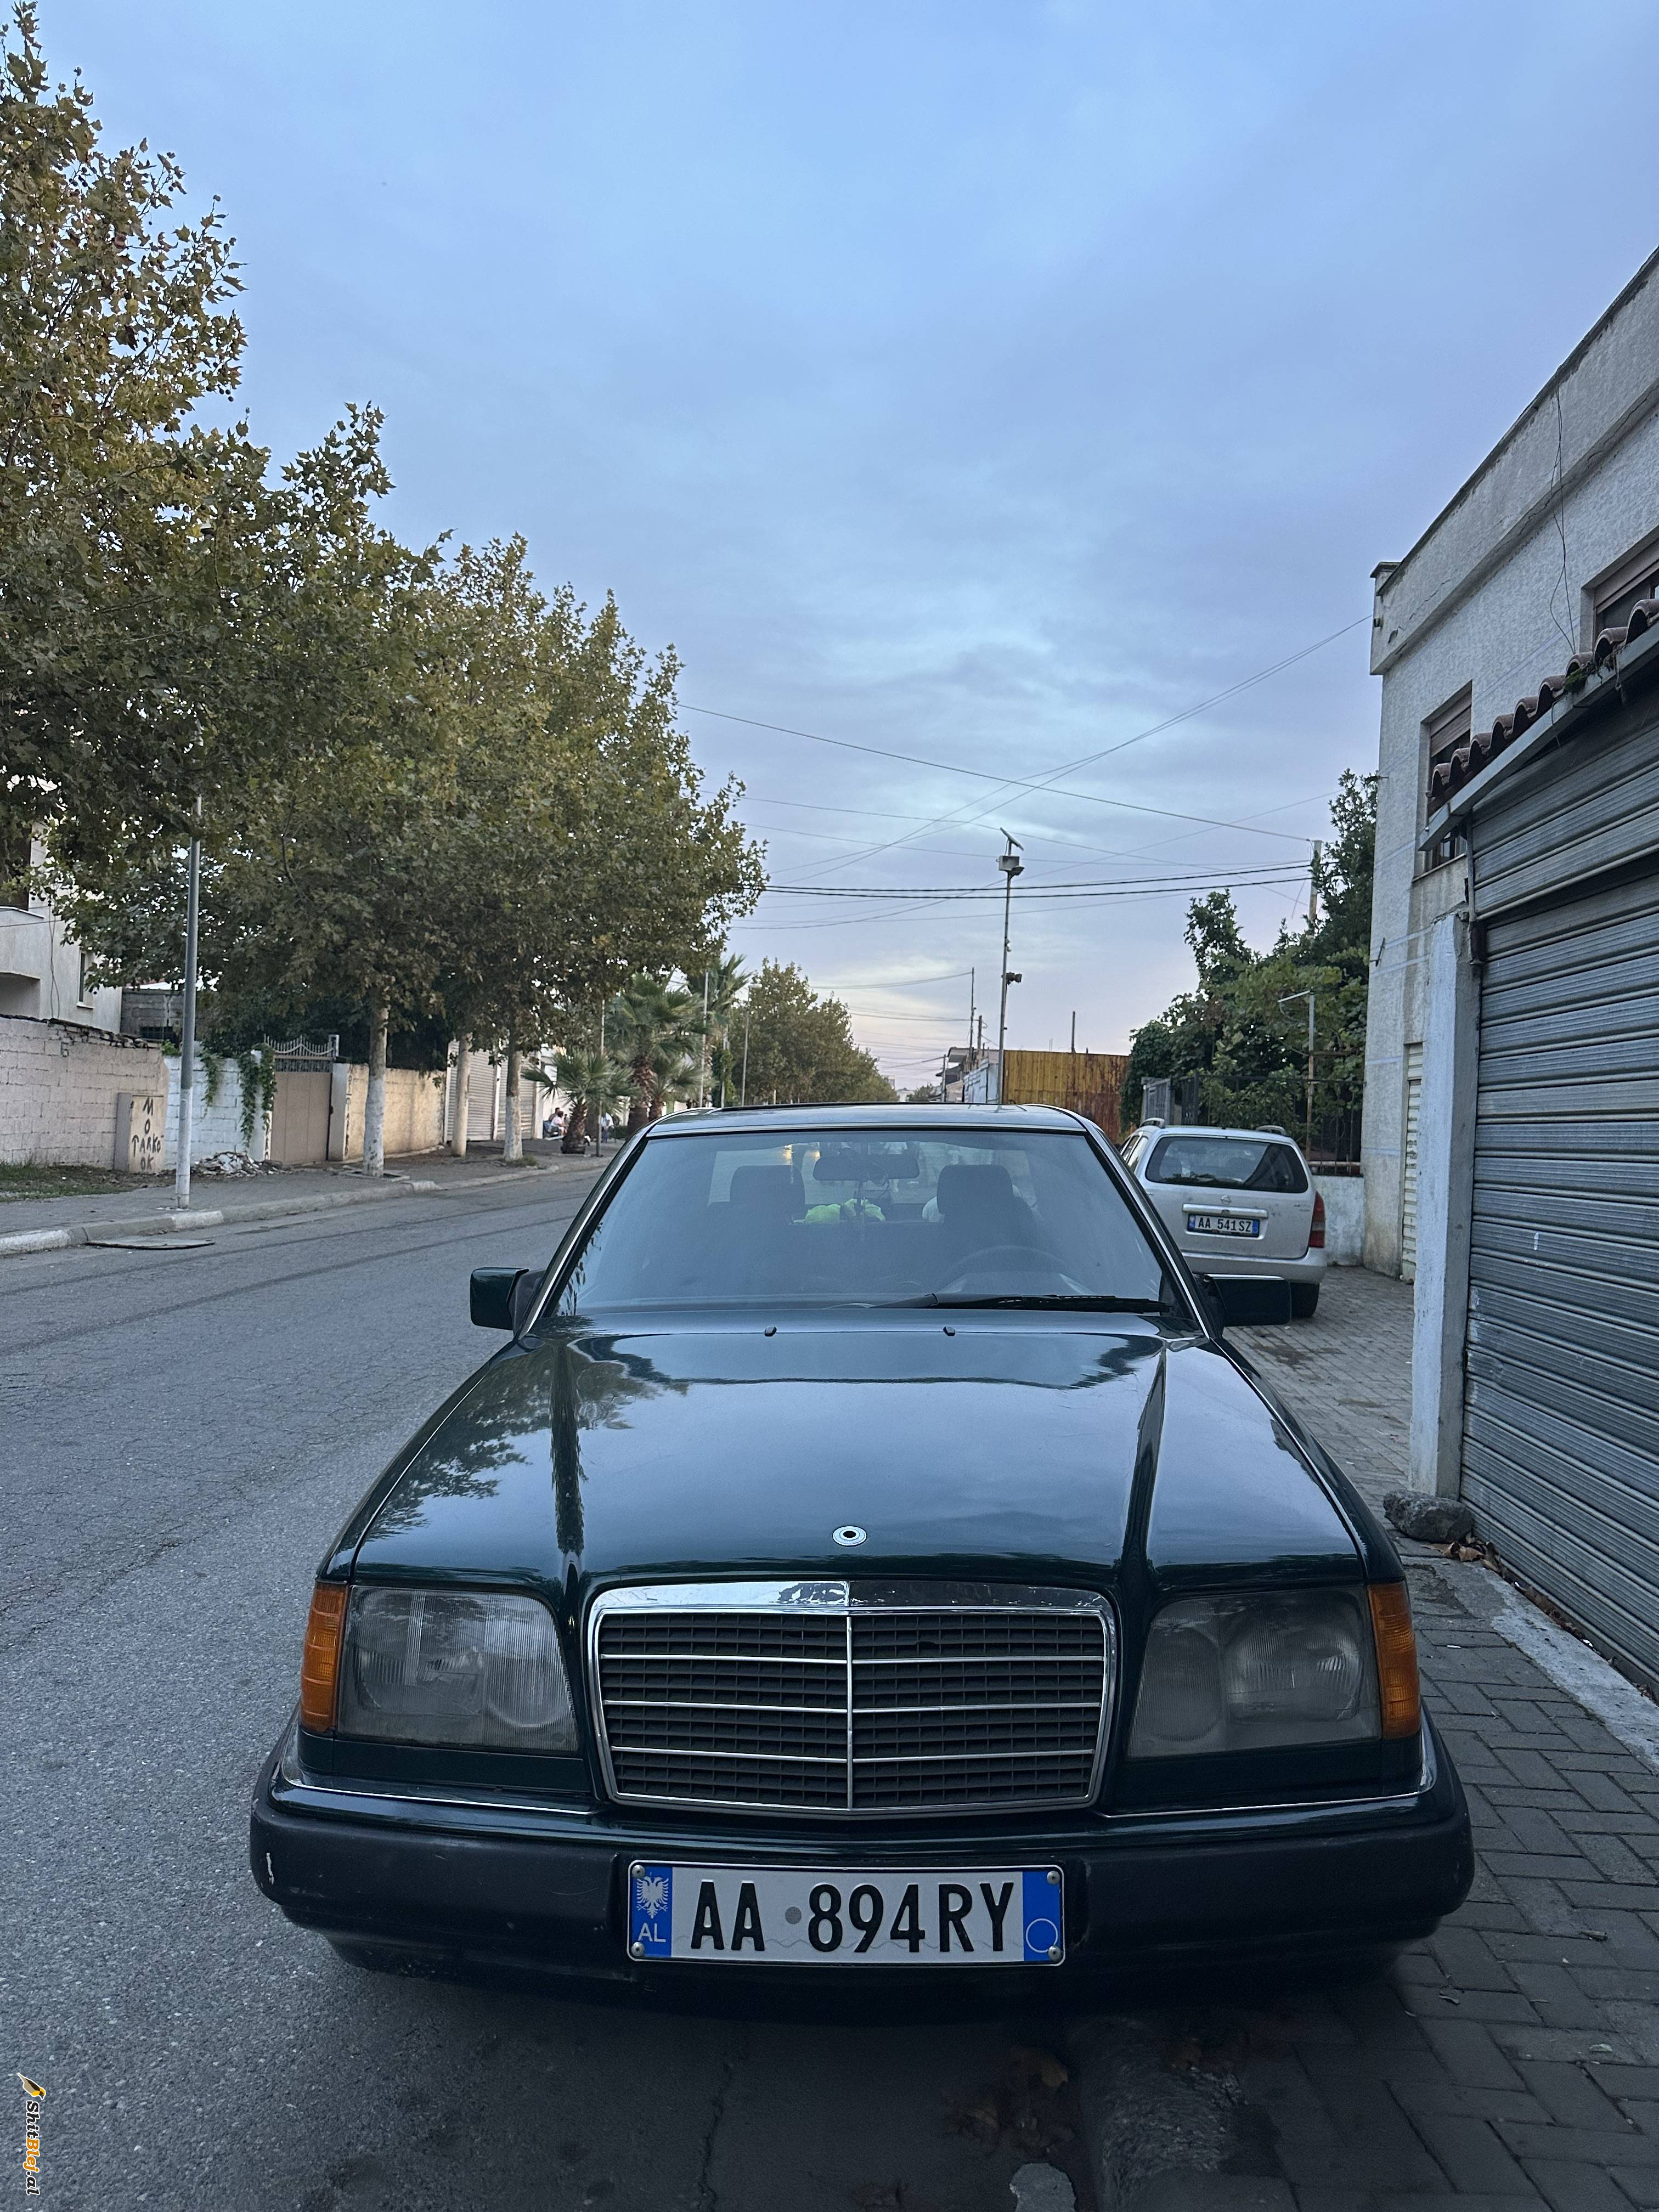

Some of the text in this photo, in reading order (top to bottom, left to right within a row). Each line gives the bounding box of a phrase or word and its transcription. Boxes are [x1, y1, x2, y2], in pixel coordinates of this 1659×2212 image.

[140, 1154, 154, 1170] OK
[1198, 1217, 1211, 1228] AA
[691, 1880, 765, 1951] AA
[637, 1922, 667, 1943] AL
